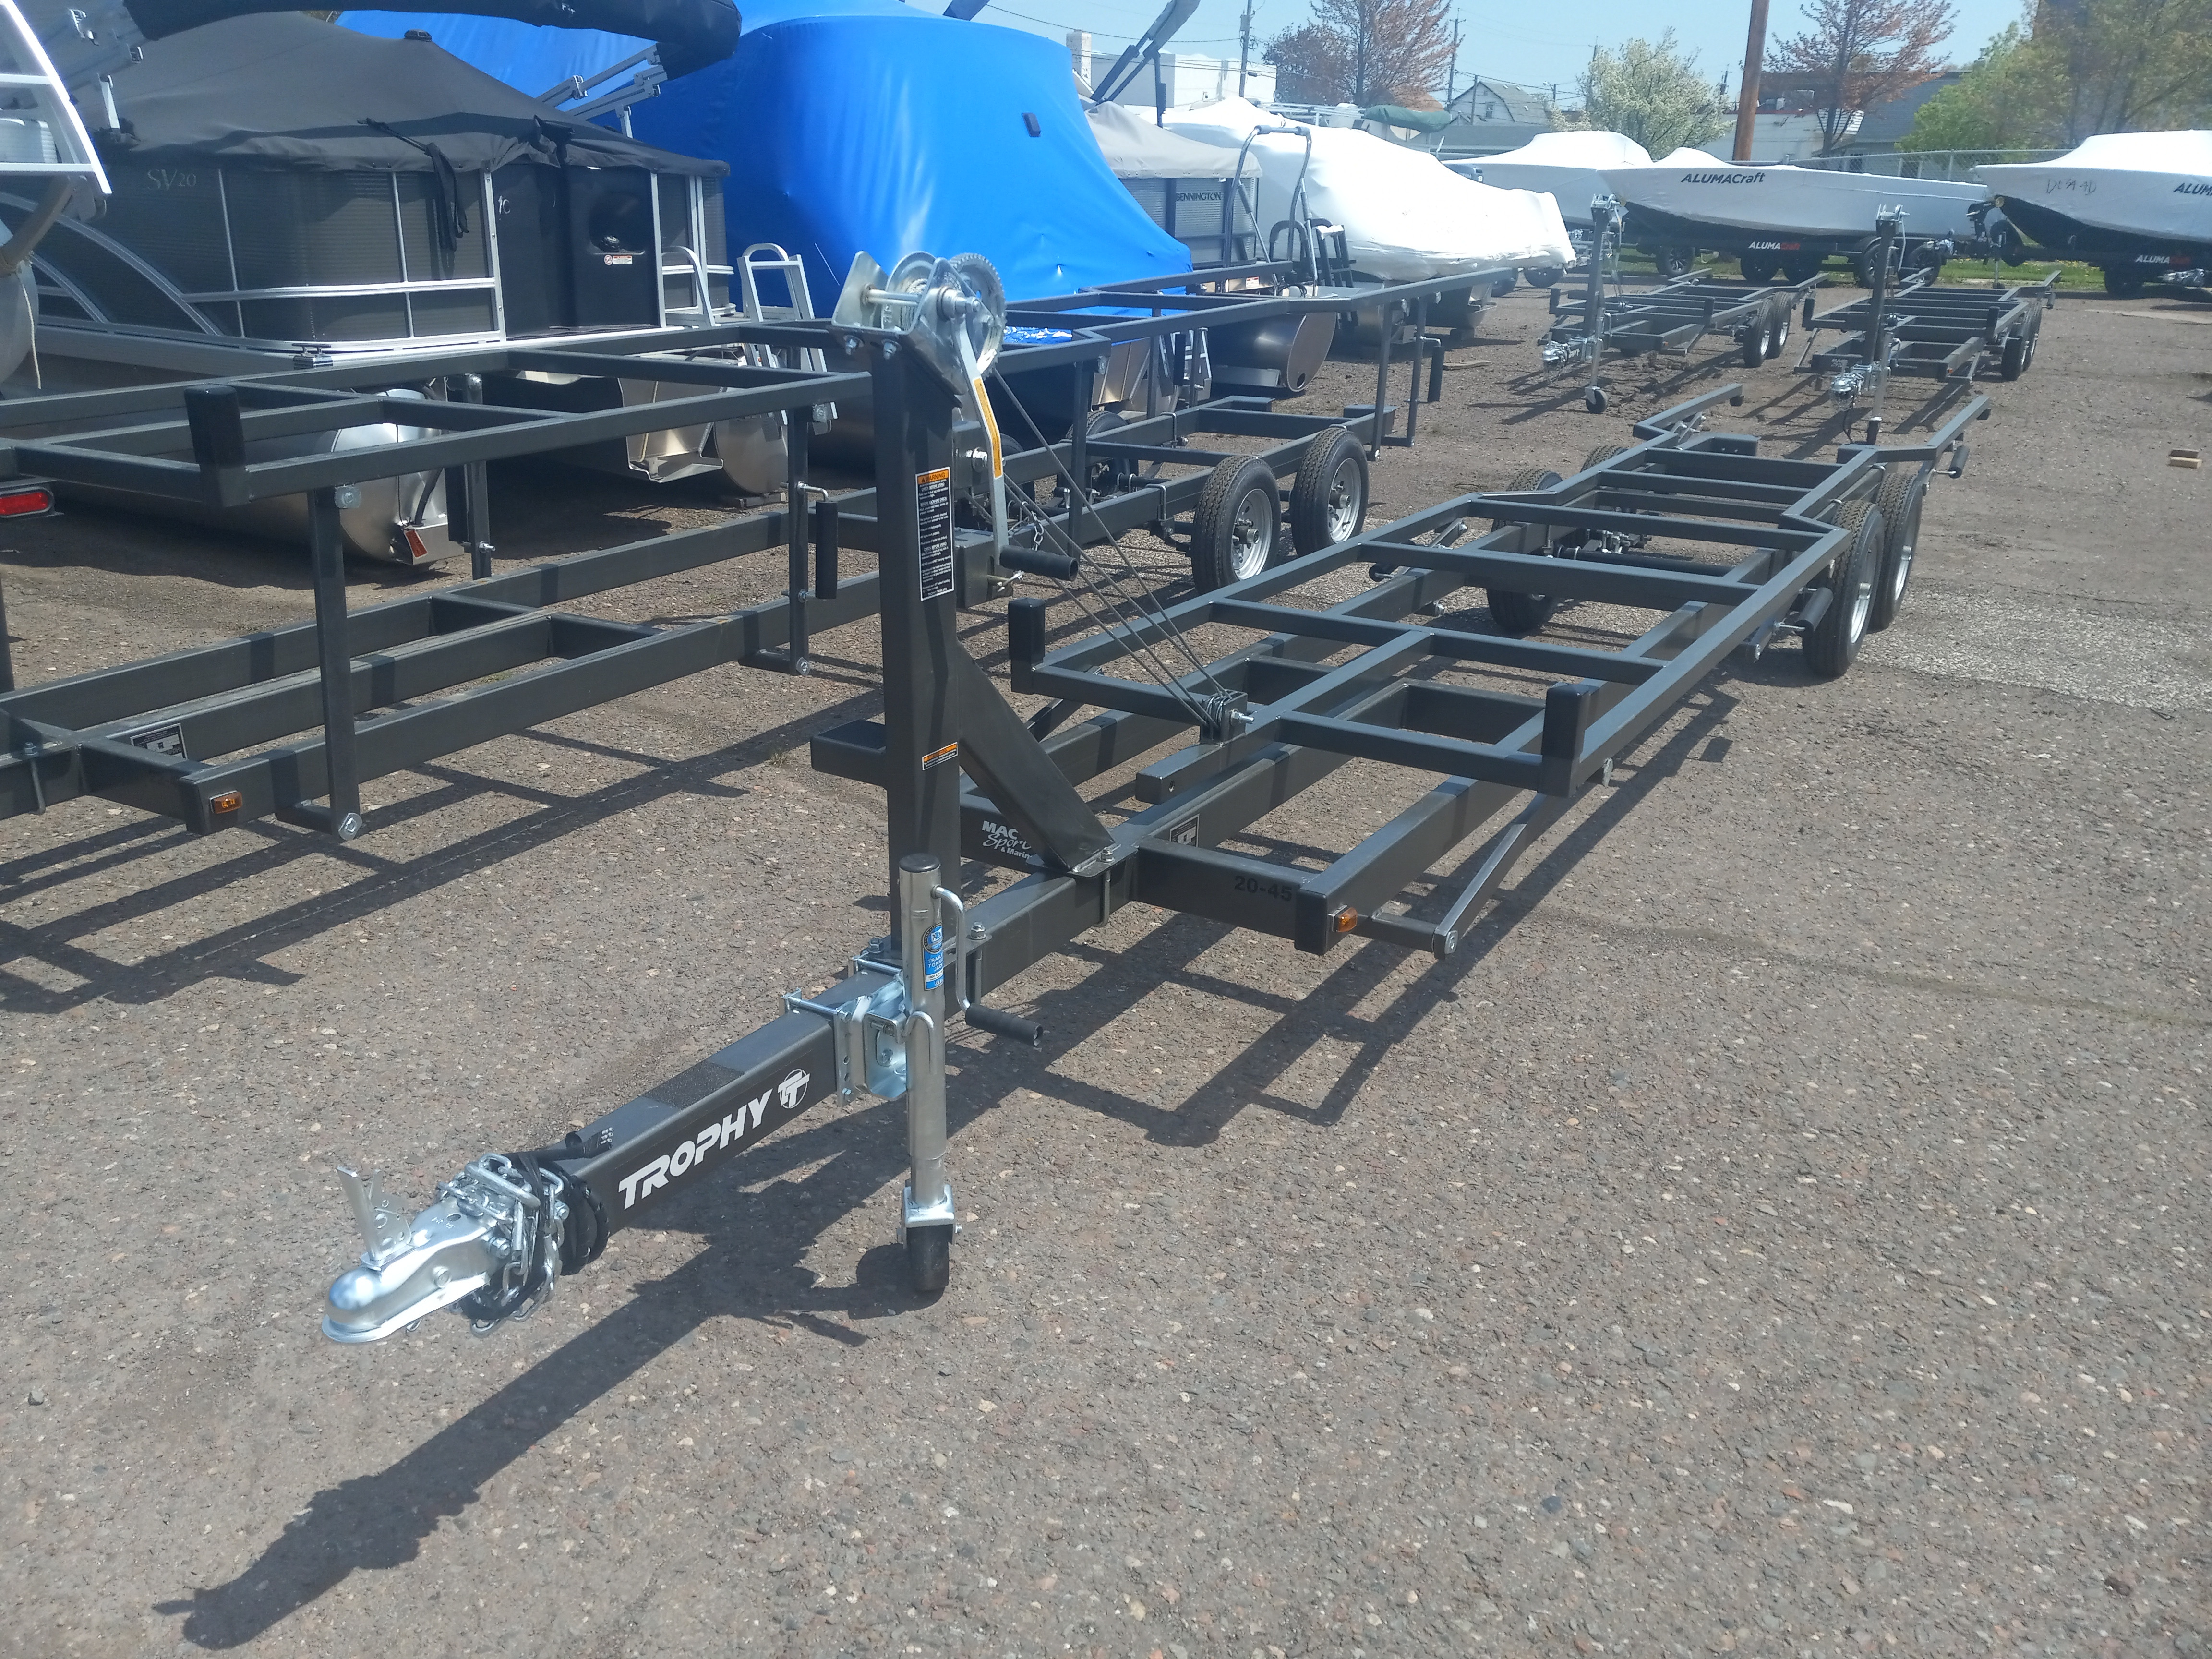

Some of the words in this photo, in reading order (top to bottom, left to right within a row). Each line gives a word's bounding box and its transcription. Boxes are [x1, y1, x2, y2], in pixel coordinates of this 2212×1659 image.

[1681, 172, 1766, 184] ALUMACraft
[2173, 183, 2212, 196] ALUM
[1176, 192, 1221, 201] BENNINGTON
[925, 472, 945, 482] WARNING
[982, 820, 1019, 840] MAC
[1007, 848, 1033, 859] Marin
[1234, 875, 1292, 902] 20-45
[618, 1088, 773, 1210] TROPHY
